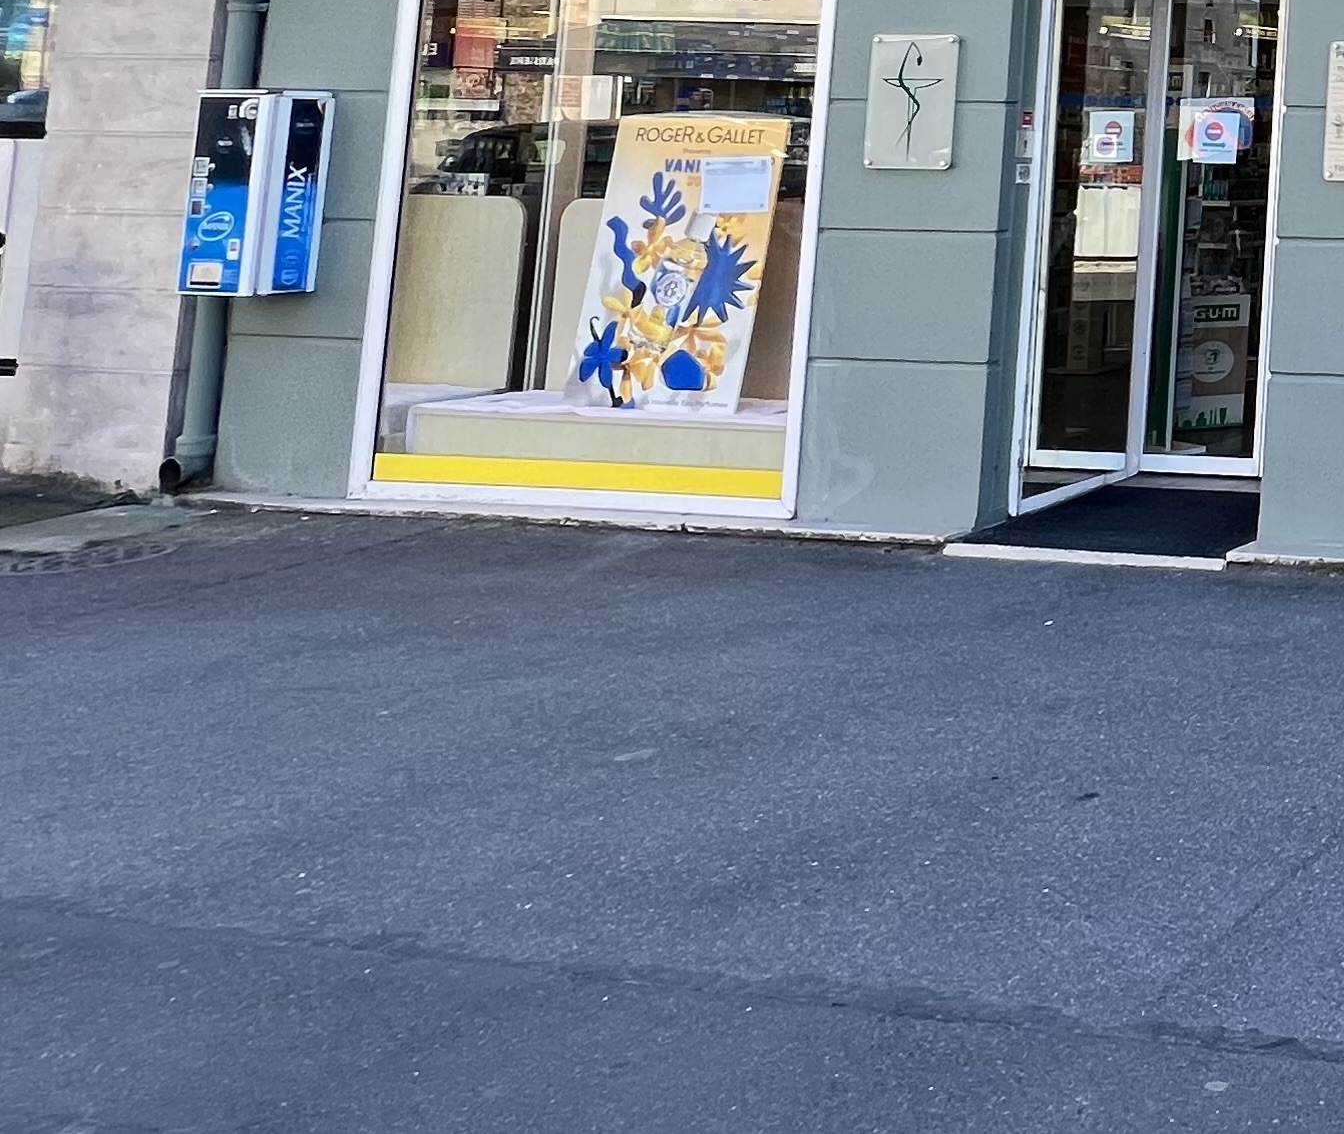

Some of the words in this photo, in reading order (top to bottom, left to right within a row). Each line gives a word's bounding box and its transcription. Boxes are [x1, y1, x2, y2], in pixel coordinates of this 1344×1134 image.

[635, 126, 695, 143] ROGER
[707, 126, 766, 145] GALLET
[281, 165, 308, 240] MANIX
